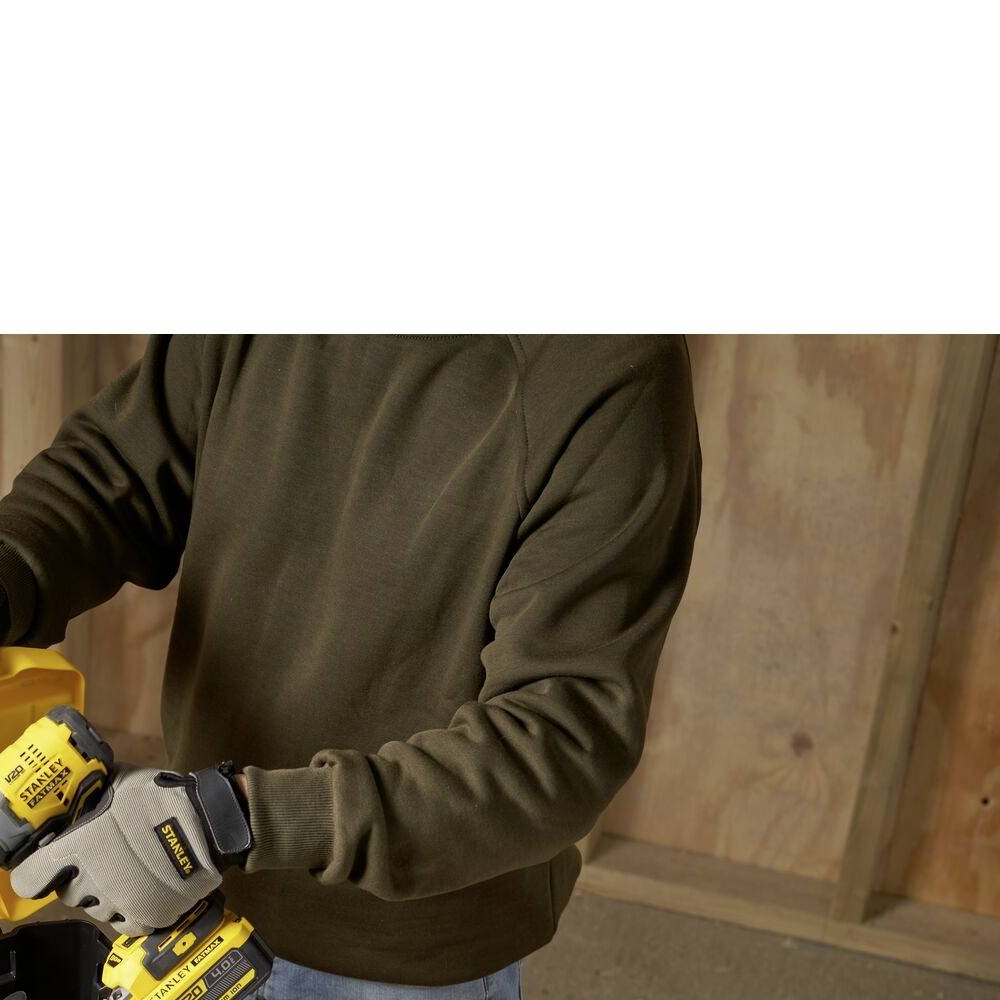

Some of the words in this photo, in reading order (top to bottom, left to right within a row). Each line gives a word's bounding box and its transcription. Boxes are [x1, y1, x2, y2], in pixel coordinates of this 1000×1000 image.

[20, 758, 63, 801] STANLEY
[28, 767, 70, 808] FATMAX
[161, 823, 193, 872] STANLEY
[192, 938, 222, 966] FATMAX
[211, 960, 231, 978] 4.0
